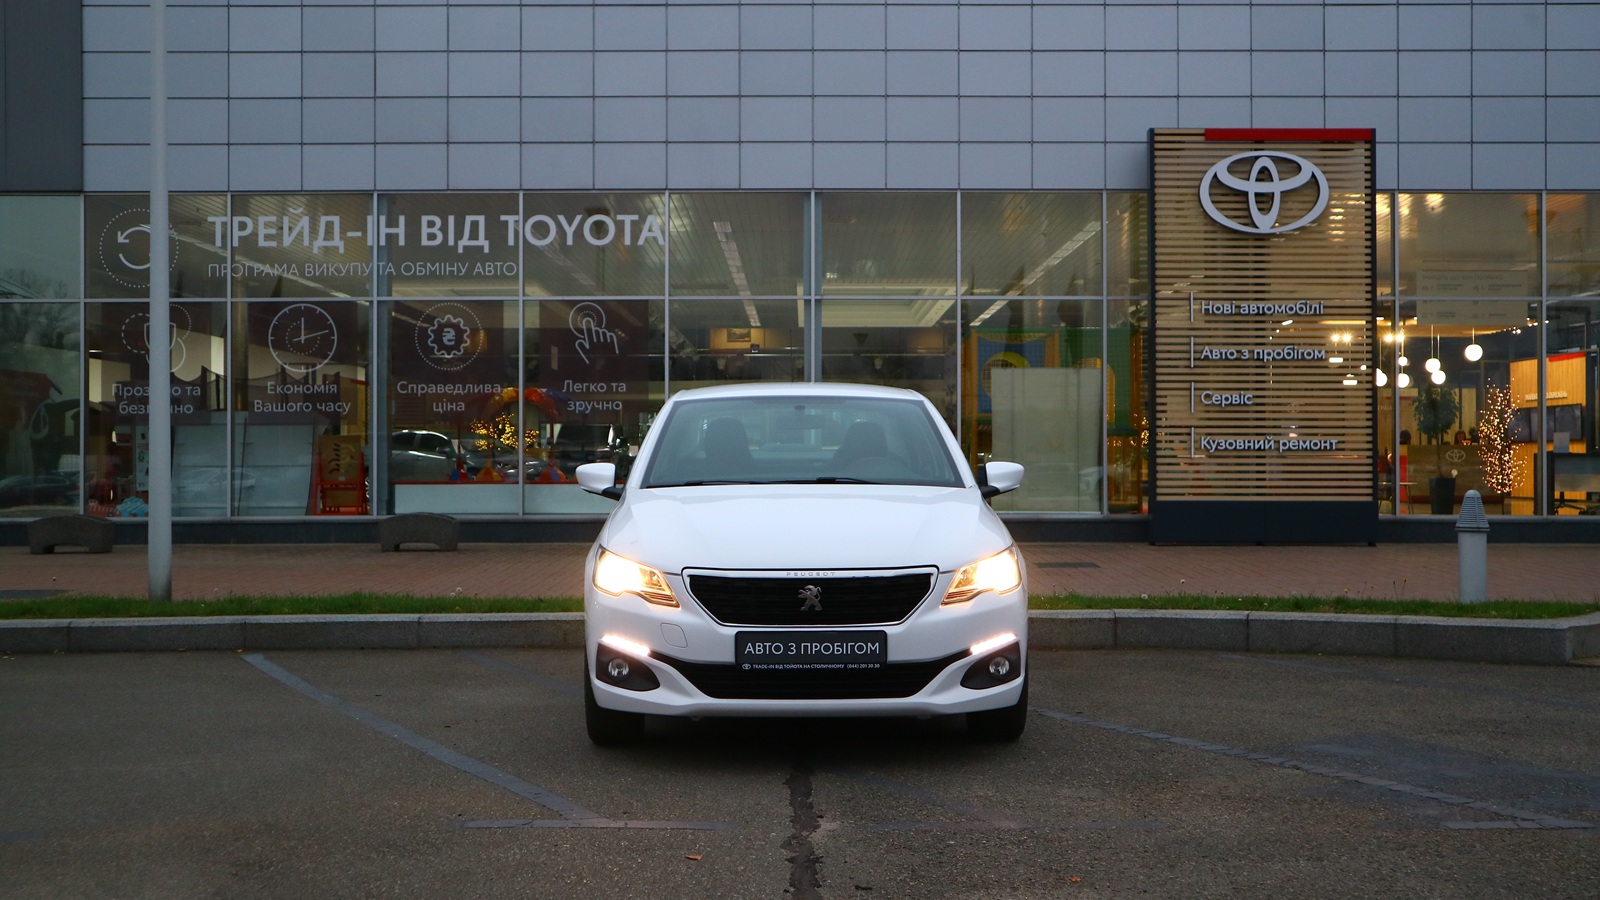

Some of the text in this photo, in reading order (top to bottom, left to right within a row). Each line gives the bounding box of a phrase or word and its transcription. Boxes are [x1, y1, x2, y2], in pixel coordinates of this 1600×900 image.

[207, 207, 666, 254] ТРЕЙД-ІН ВІД TOYOTA
[208, 262, 518, 278] ПРОГРАМА ВИКУПУ ТА ОБМІНУ АВТО
[1200, 300, 1325, 315] Нові автомобілі
[1200, 345, 1326, 363] Авто з пробігом
[112, 383, 201, 399] Прозо та
[267, 381, 337, 394] Економія
[396, 380, 501, 396] Справедлива
[562, 380, 627, 393] Легко та
[253, 399, 352, 415] Вашого часу
[432, 399, 465, 413] ціна
[567, 400, 623, 414] зручно
[1200, 391, 1254, 407] Сервіс
[119, 401, 194, 414] безно
[1200, 435, 1338, 453] Кузовний ремонт
[744, 642, 784, 655] АВТО
[801, 642, 880, 655] ПРОБІГОМ
